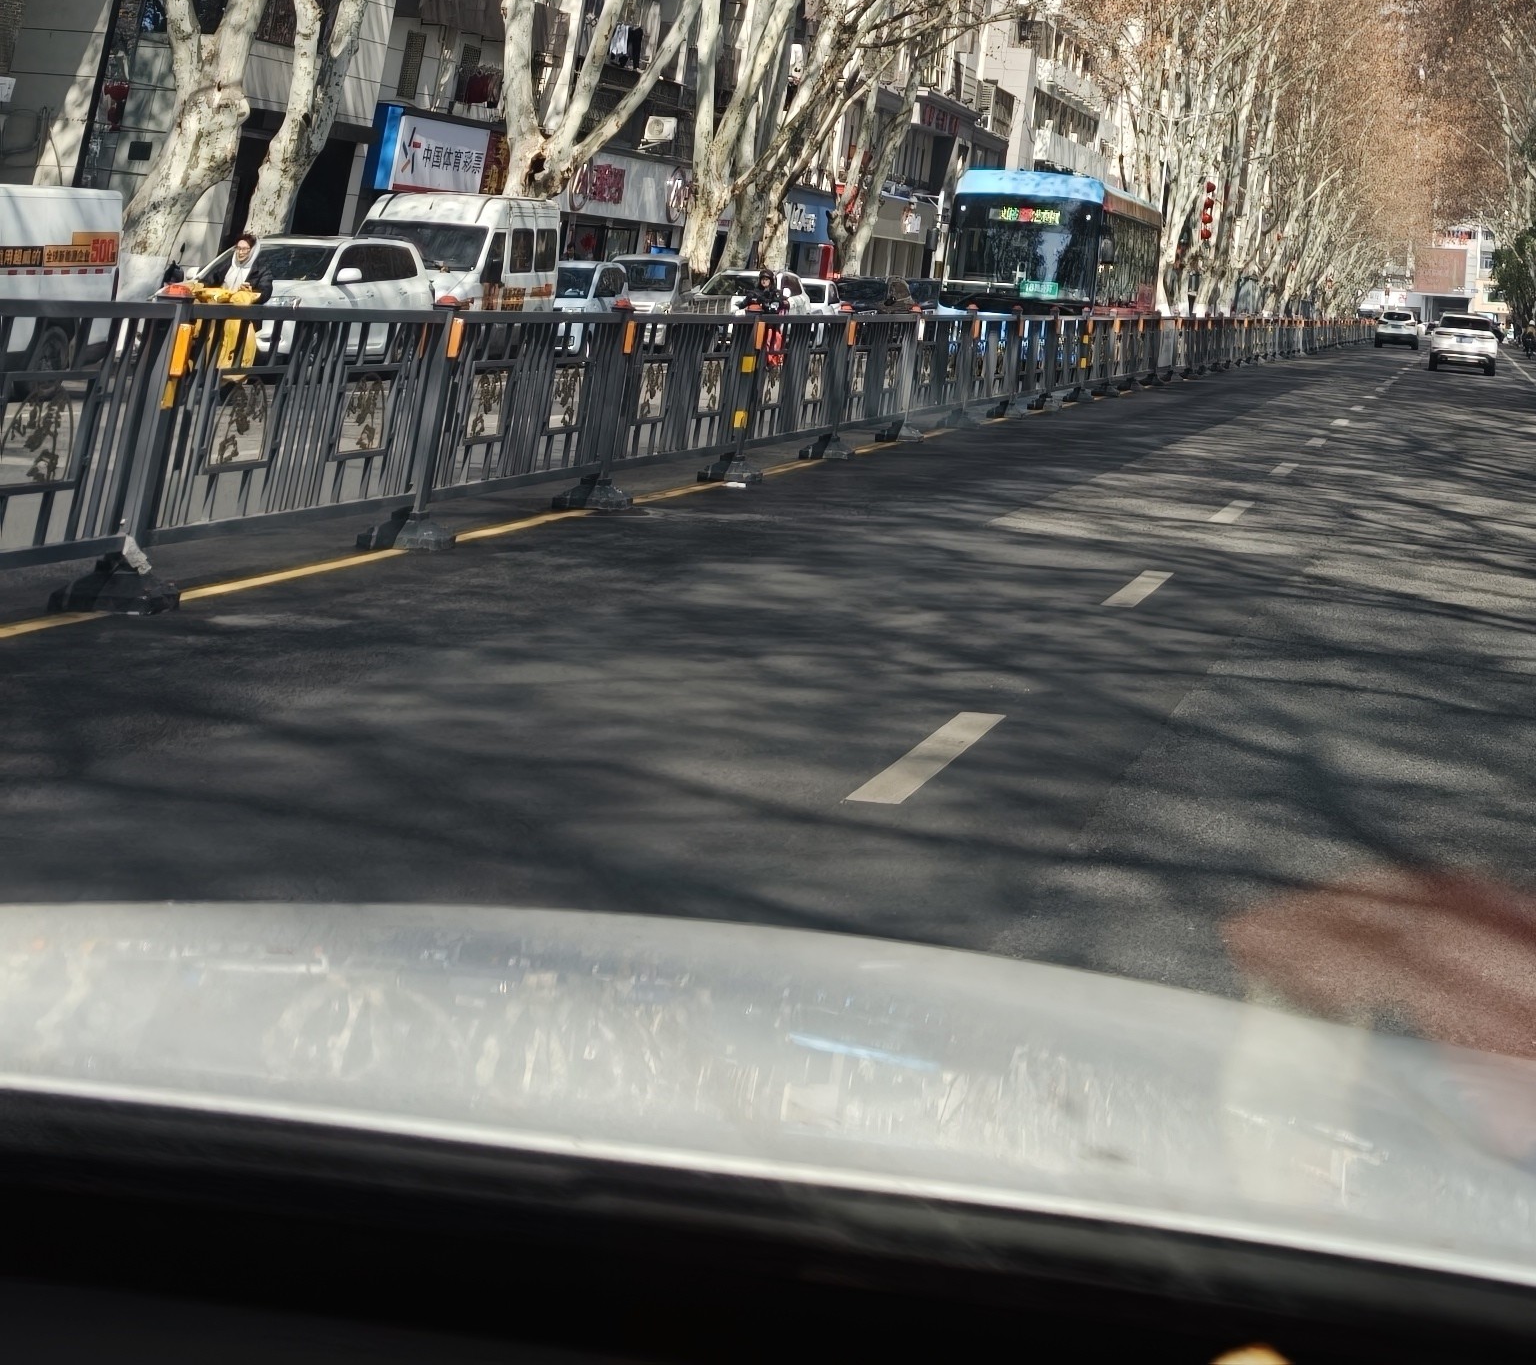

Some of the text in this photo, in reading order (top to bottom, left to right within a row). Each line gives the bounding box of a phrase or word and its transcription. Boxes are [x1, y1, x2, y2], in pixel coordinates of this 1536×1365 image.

[422, 144, 485, 175] 中国体育彩票
